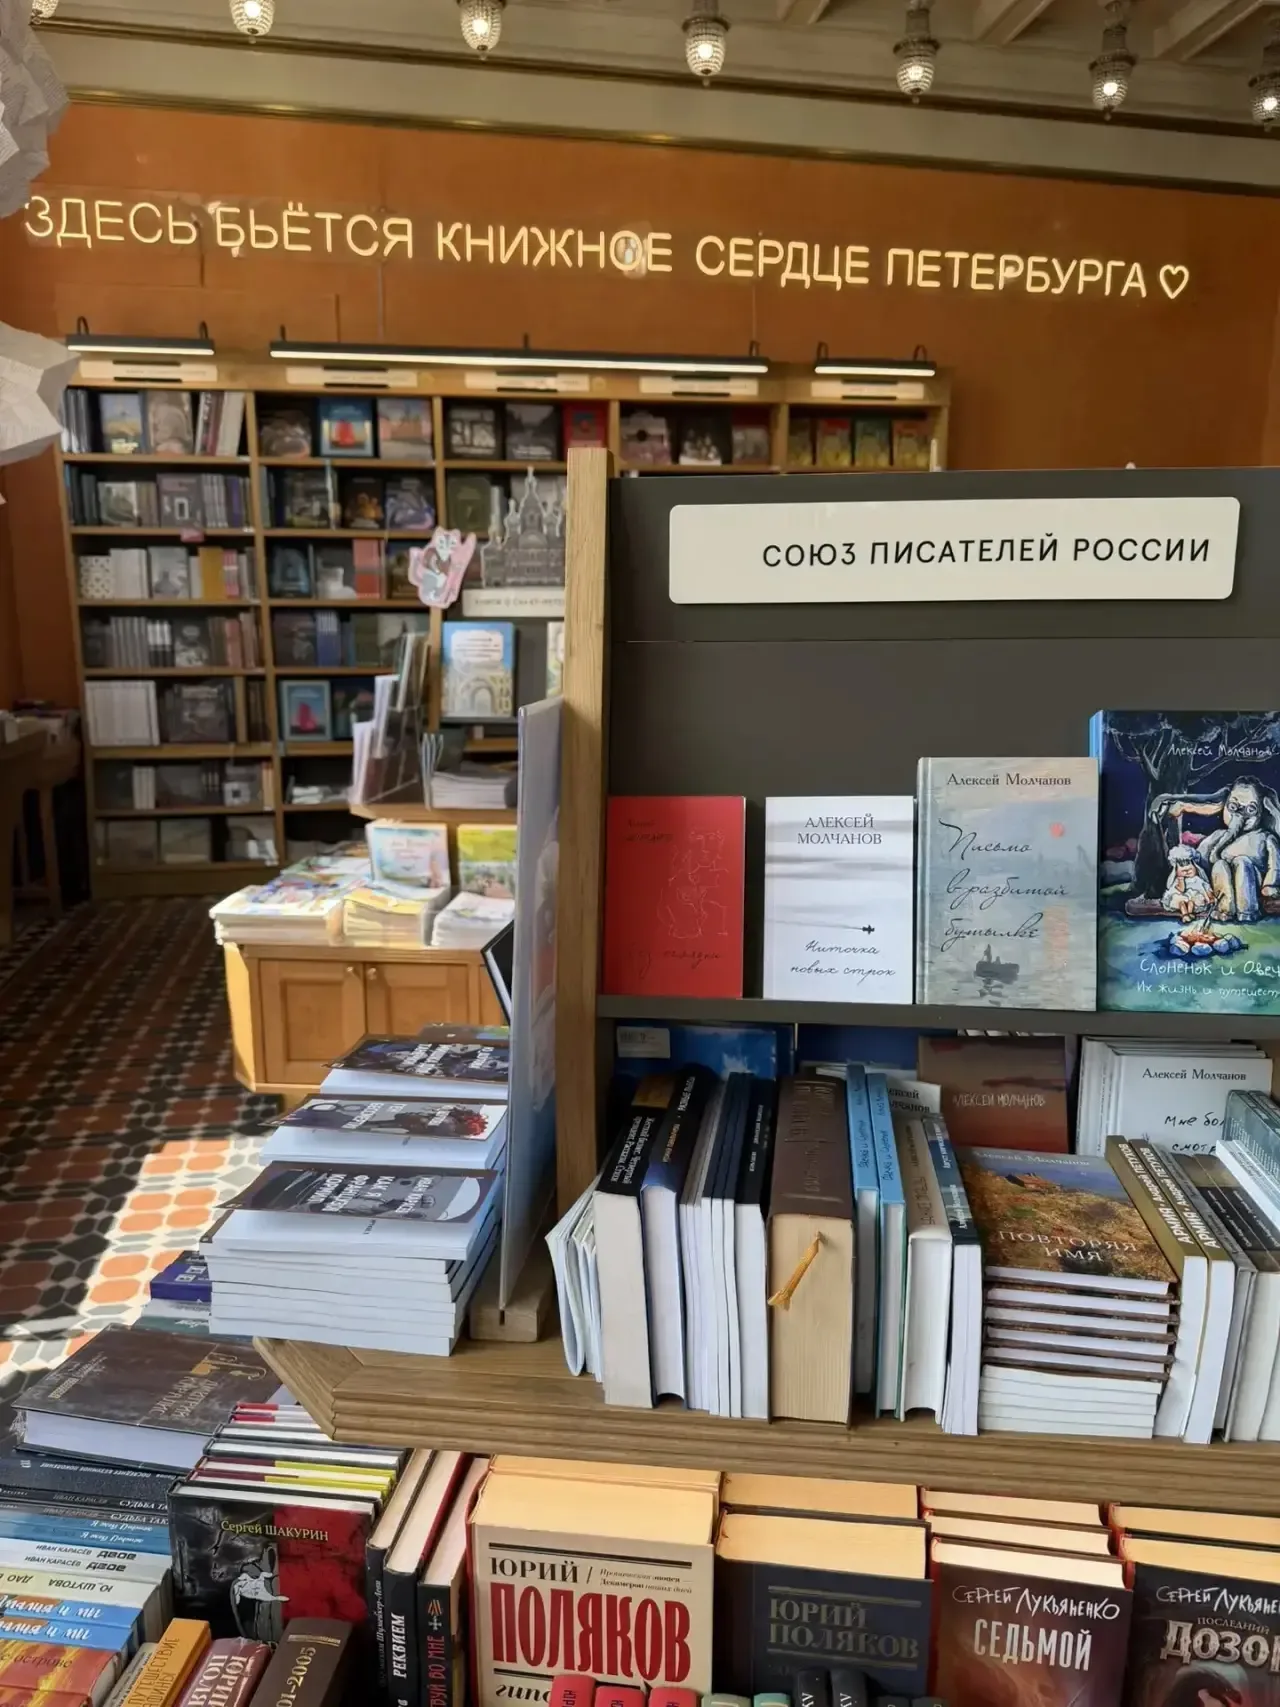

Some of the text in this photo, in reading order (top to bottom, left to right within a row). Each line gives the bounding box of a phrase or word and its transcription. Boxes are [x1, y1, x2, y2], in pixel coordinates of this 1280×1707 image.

[24, 195, 1148, 298] ЗДЕСЬ БЬЁТСЯ КНИЖНОЕ СЕРДЦЕ ПЕТЕРБУРГА
[761, 532, 1210, 568] СОЮЗ ПИСАТЕЛЕЙ РОССИИ
[946, 772, 1072, 787] Алексей Молчанов
[804, 813, 875, 829] АЛЕКСЕЙ
[797, 832, 882, 846] МОЛЧАНОВ
[940, 912, 1044, 953] бутылке
[804, 939, 880, 956] Ниточка
[790, 964, 897, 986] новых строк
[1140, 958, 1280, 978] Слоненок и Овеч
[1137, 980, 1280, 999] Их жизнь и путешест
[1142, 1067, 1248, 1081] Алексей Молчанов
[1164, 1115, 1198, 1127] Мне
[1118, 1143, 1195, 1246] АРМИЯ Андрей ПЕТУХОВ
[1140, 1147, 1221, 1249] АРМИЯ Андрей ПЕТУХОВ
[999, 1229, 1138, 1252] ПОВТОРЯЯ
[1045, 1247, 1106, 1263] ИМЯ
[220, 1519, 330, 1542] Сергей ШАКУРИН
[24, 1555, 46, 1564] ИВАН
[36, 1544, 57, 1552] ИВАН
[7, 1573, 34, 1584] ДАО
[490, 1557, 580, 1585] ЮРИЙ
[768, 1597, 869, 1629] ЮРИЙ
[490, 1581, 692, 1683] ПОЛЯКОВ
[1197, 1616, 1270, 1635] ПОСЛЕДНИЙ
[390, 1612, 407, 1679] РЕКВИЕМ
[427, 1634, 446, 1661] МНЕ
[767, 1622, 920, 1659] ПОЛЯКОВ
[973, 1618, 1093, 1672] СЕДЬМОЙ
[127, 1636, 181, 1705] ПУТЕШЕСТВИЕ
[187, 1654, 229, 1707] ПОЛЯ
[276, 1647, 316, 1707] 01-2005
